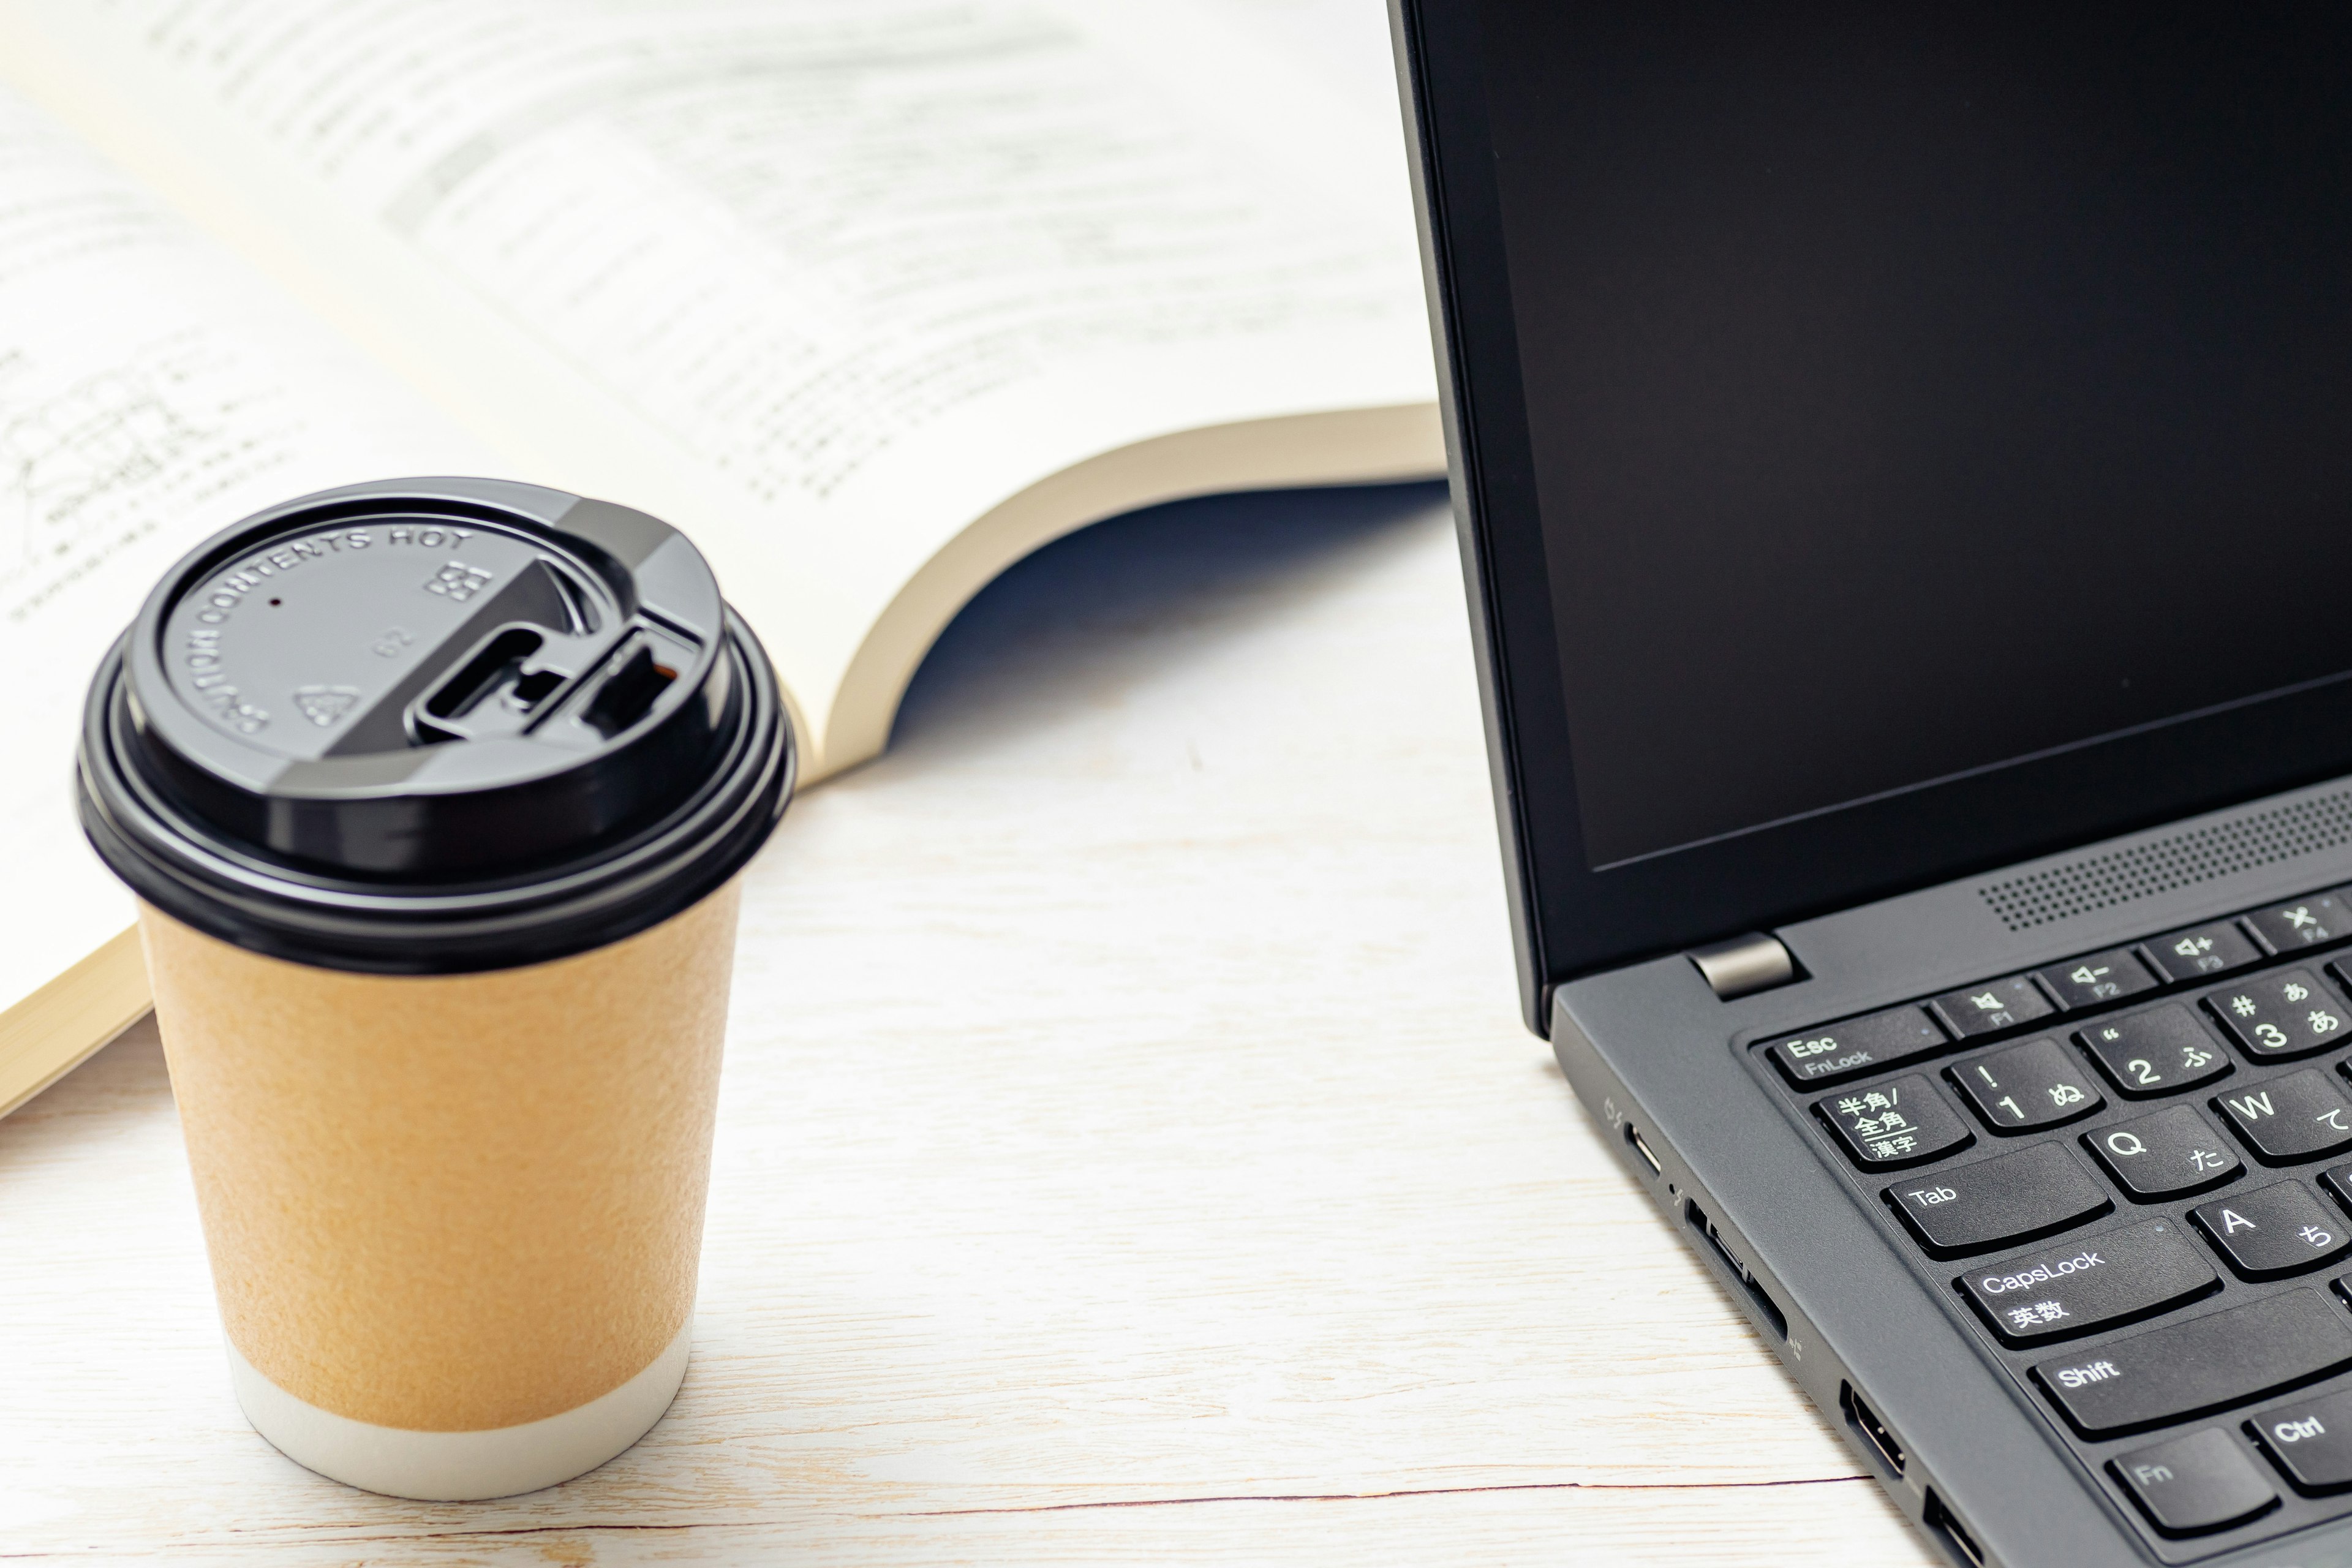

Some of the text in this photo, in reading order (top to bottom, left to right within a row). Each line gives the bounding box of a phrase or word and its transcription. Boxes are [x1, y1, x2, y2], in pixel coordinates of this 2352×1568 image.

[197, 529, 371, 622] CONTENTS
[389, 527, 473, 550] HOT
[2092, 982, 2120, 998] F2
[2233, 995, 2256, 1017] #
[1990, 1011, 2014, 1026] F1
[2255, 1011, 2339, 1047] 3 あ
[1787, 1038, 1837, 1058] Esc
[1804, 1051, 1872, 1076] FnLock
[2128, 1047, 2212, 1084] 2 ふ
[1978, 1066, 1997, 1087] !
[1839, 1088, 1898, 1116] 半角/
[1999, 1084, 2084, 1118] 1 ぬ
[2229, 1091, 2274, 1120] W
[1855, 1111, 1907, 1136] 全角
[2316, 1109, 2349, 1130] て
[1870, 1134, 1917, 1158] 漢字
[2108, 1133, 2147, 1155] Q
[2190, 1149, 2224, 1171] た
[1908, 1187, 1956, 1206] Tab
[2223, 1209, 2256, 1233] A
[2299, 1225, 2331, 1247] ち
[1981, 1252, 2105, 1293] CapsLock
[2008, 1301, 2070, 1329] 英数
[2058, 1361, 2120, 1387] Shift
[2274, 1416, 2324, 1442] Ctrl
[2135, 1465, 2173, 1485] Fn
